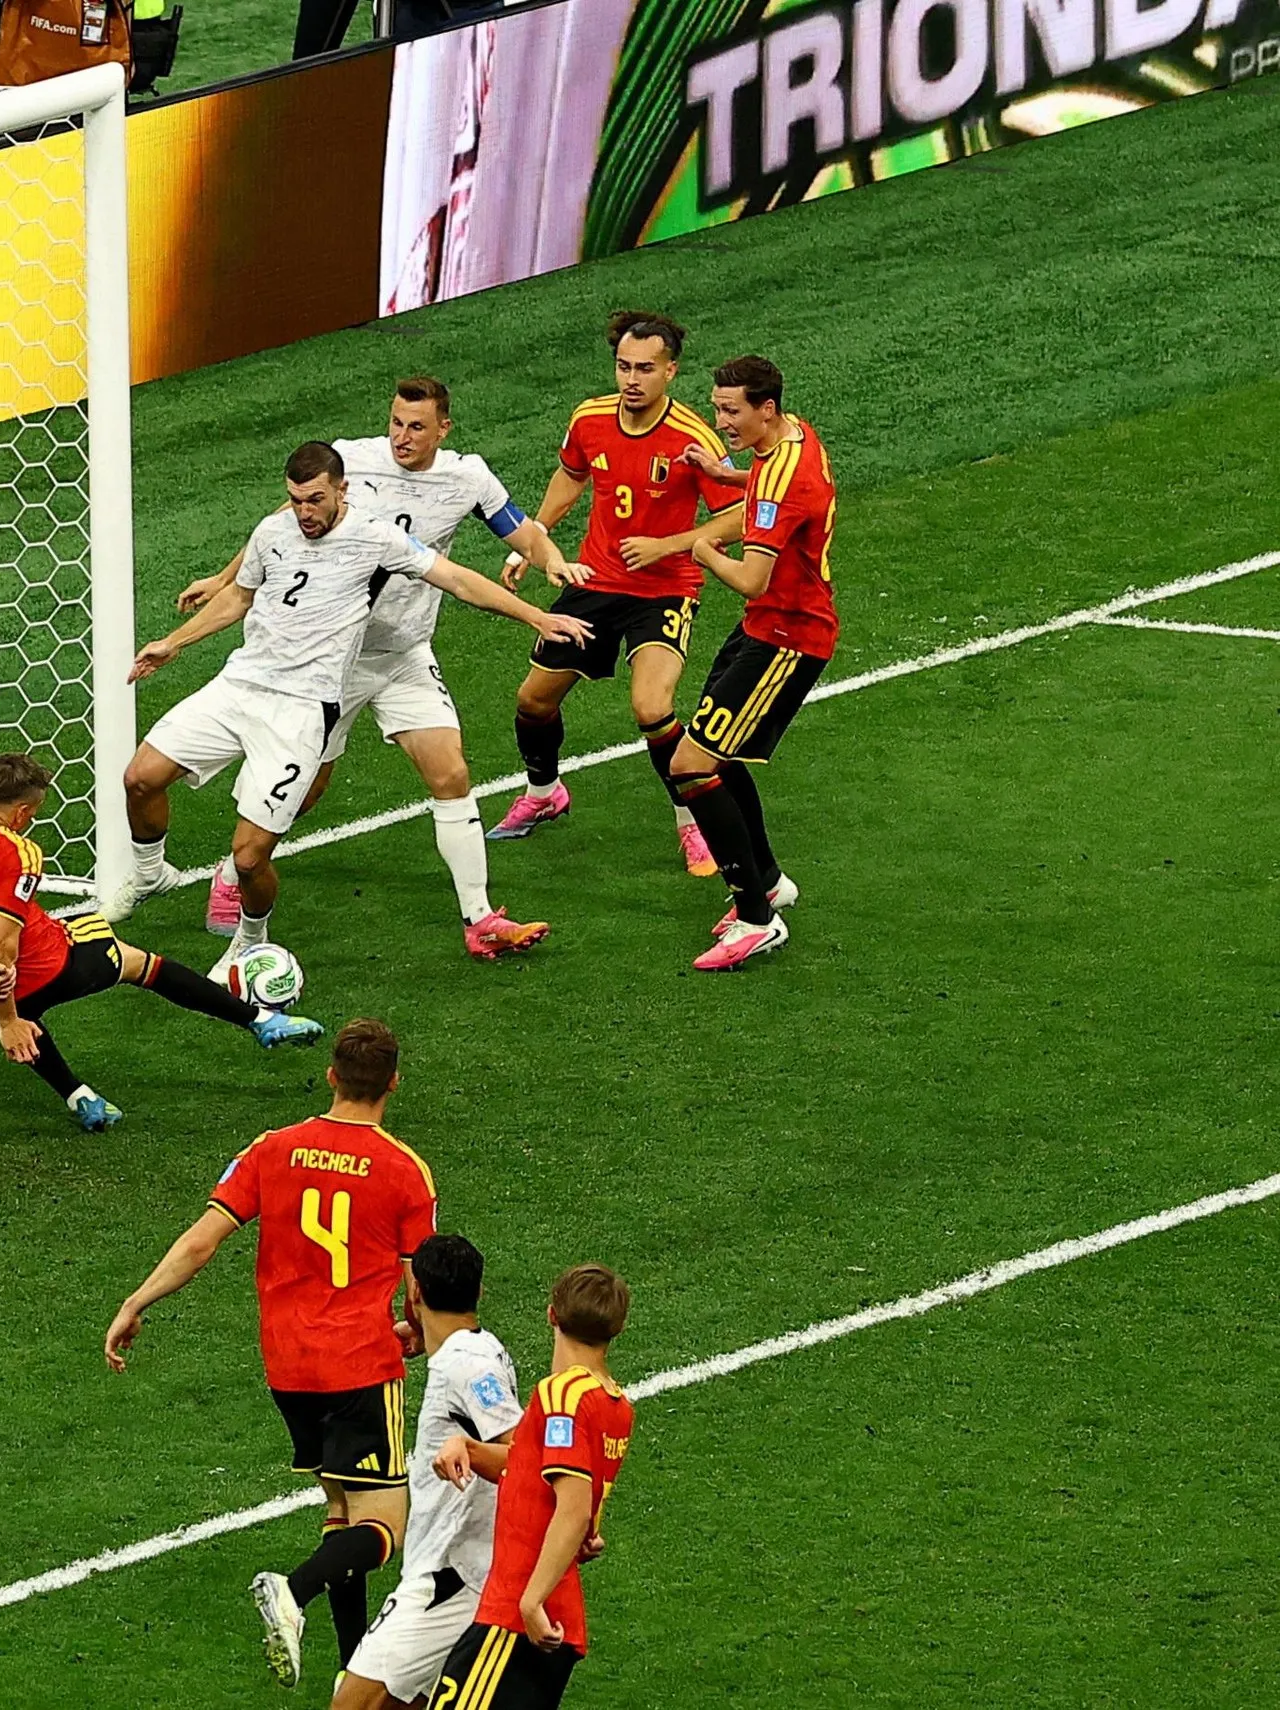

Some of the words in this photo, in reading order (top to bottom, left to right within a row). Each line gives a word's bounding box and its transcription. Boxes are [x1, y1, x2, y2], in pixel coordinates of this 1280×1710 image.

[30, 15, 77, 36] FIFA.com
[686, 0, 1241, 198] TRIOND
[614, 484, 633, 519] 3
[282, 570, 309, 607] 2
[662, 608, 681, 639] 3
[692, 695, 733, 741] 20
[270, 763, 301, 801] 2
[290, 1147, 371, 1177] MECHELE
[300, 1187, 351, 1289] 4
